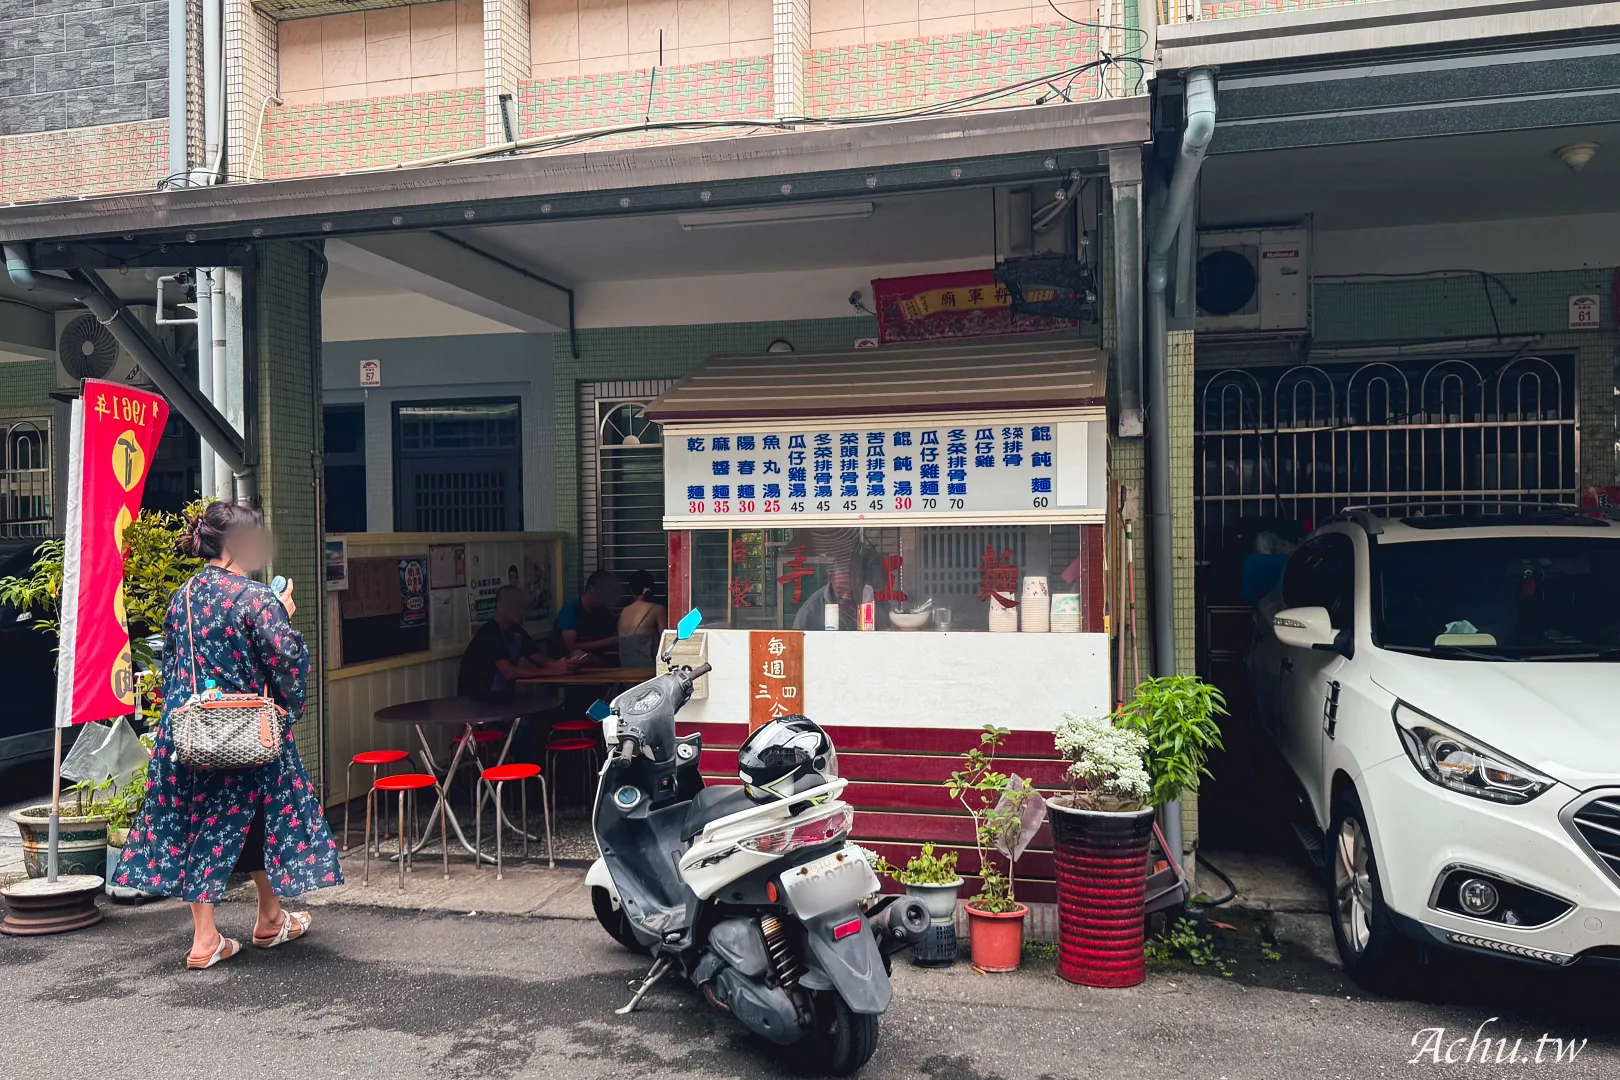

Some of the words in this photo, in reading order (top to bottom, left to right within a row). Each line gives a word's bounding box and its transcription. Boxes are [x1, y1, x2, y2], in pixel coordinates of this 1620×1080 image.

[1578, 310, 1591, 321] 61
[365, 372, 375, 381] 57
[975, 428, 995, 467] 瓜仔雞
[1002, 427, 1023, 466] 冬菜排骨
[1031, 426, 1052, 493] 餛飩麵
[687, 437, 705, 499] 乾麵
[712, 437, 730, 499] 麻醬麵
[737, 436, 755, 499] 陽春麵
[762, 435, 780, 498] 魚丸湯
[788, 434, 806, 498] 瓜仔雞湯
[814, 434, 832, 497] 冬菜排骨湯
[840, 433, 858, 497] 菜頭排骨湯
[866, 432, 885, 496] 苦瓜排骨湯
[893, 431, 912, 496] 餛飩湯
[920, 430, 939, 495] 瓜仔雞麵
[947, 429, 967, 495] 冬菜排骨麵
[689, 501, 705, 513] 30
[713, 500, 730, 512] 35
[739, 500, 756, 512] 30
[764, 499, 781, 512] 25
[790, 501, 805, 512] 45
[816, 500, 830, 511] 45
[842, 500, 857, 510] 45
[869, 499, 884, 510] 45
[895, 497, 913, 509] 30
[922, 498, 937, 508] 70
[949, 498, 964, 509] 70
[1033, 496, 1049, 507] 60
